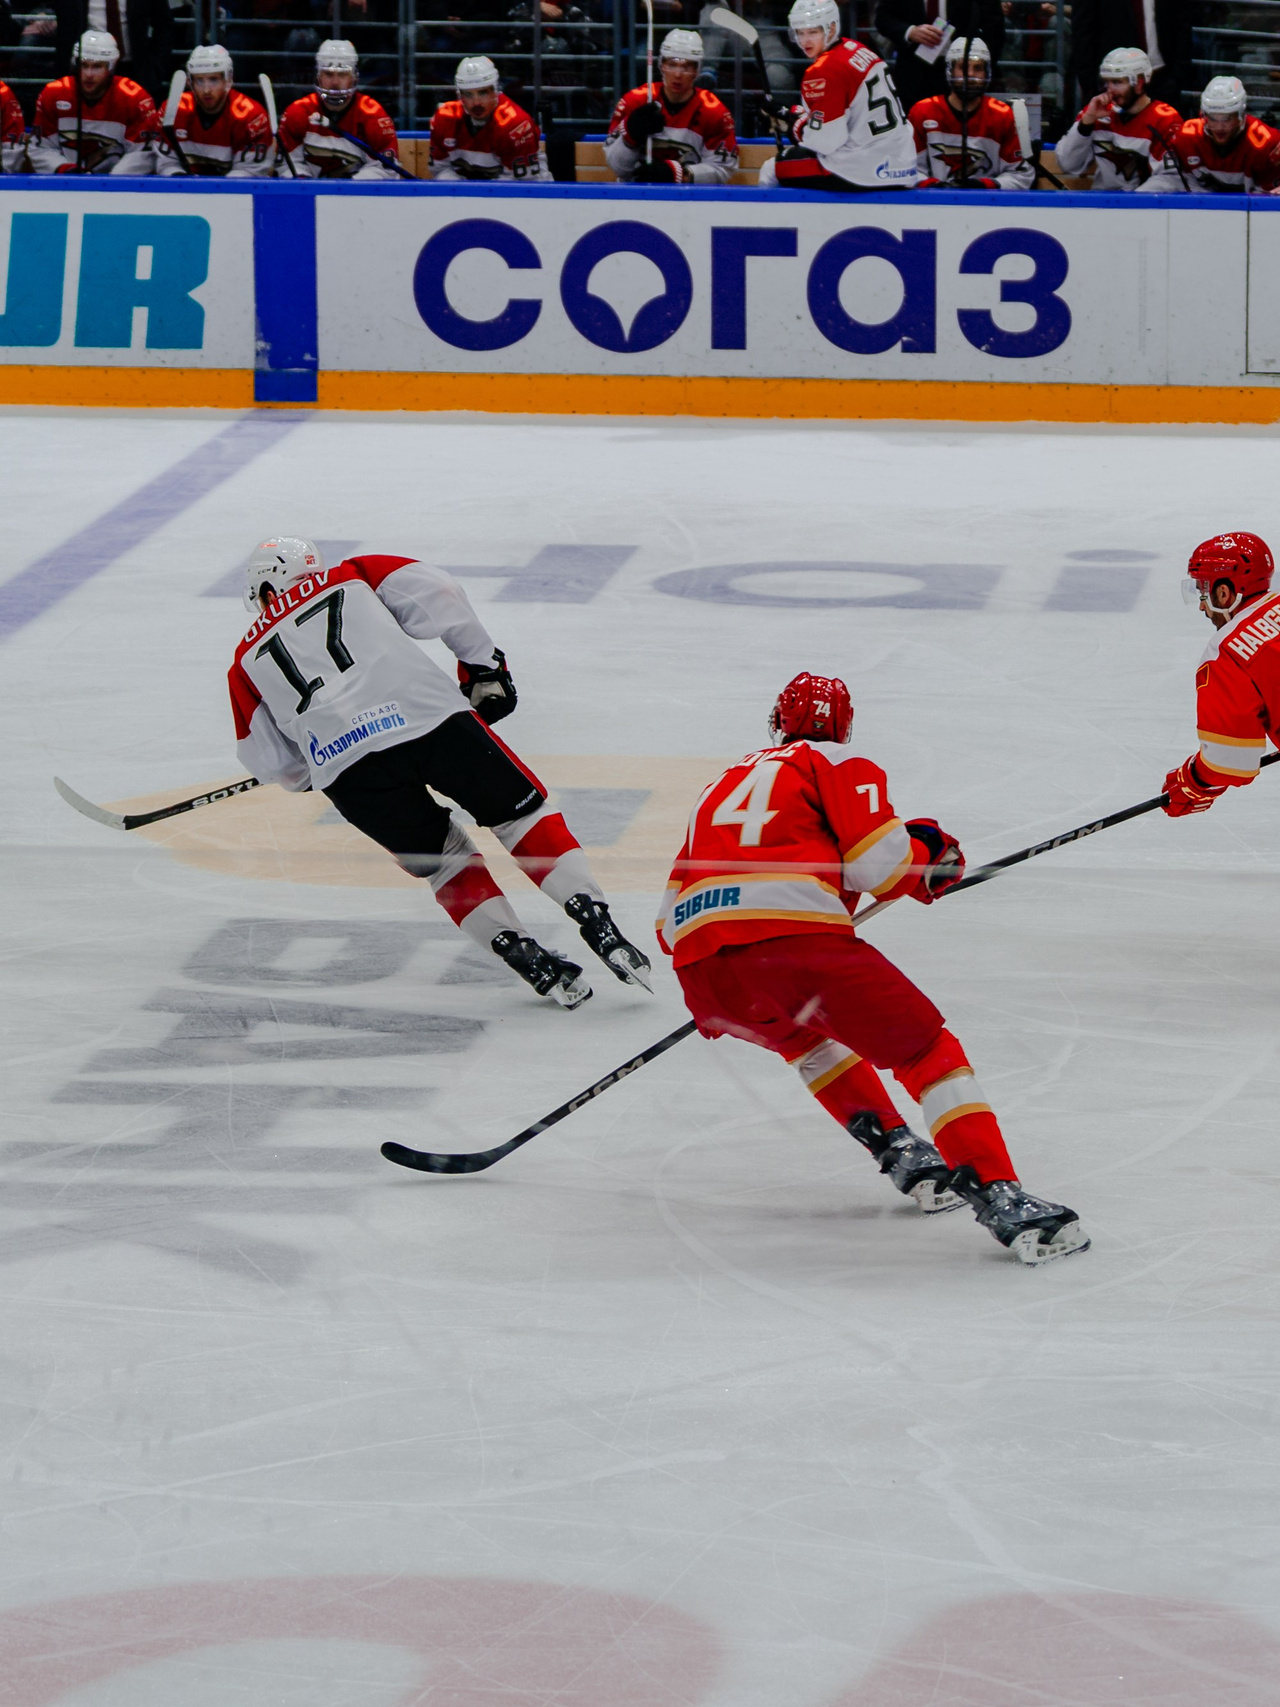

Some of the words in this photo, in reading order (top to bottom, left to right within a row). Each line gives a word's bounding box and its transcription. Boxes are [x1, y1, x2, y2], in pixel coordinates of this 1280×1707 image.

[512, 153, 541, 178] 65
[254, 587, 356, 715] 17
[352, 711, 377, 725] СЕТЬ
[378, 703, 398, 715] АЗС
[813, 700, 831, 718] 74
[324, 713, 406, 760] ГАЗПРОМНЕФТЬ
[674, 887, 741, 926] SIBUR
